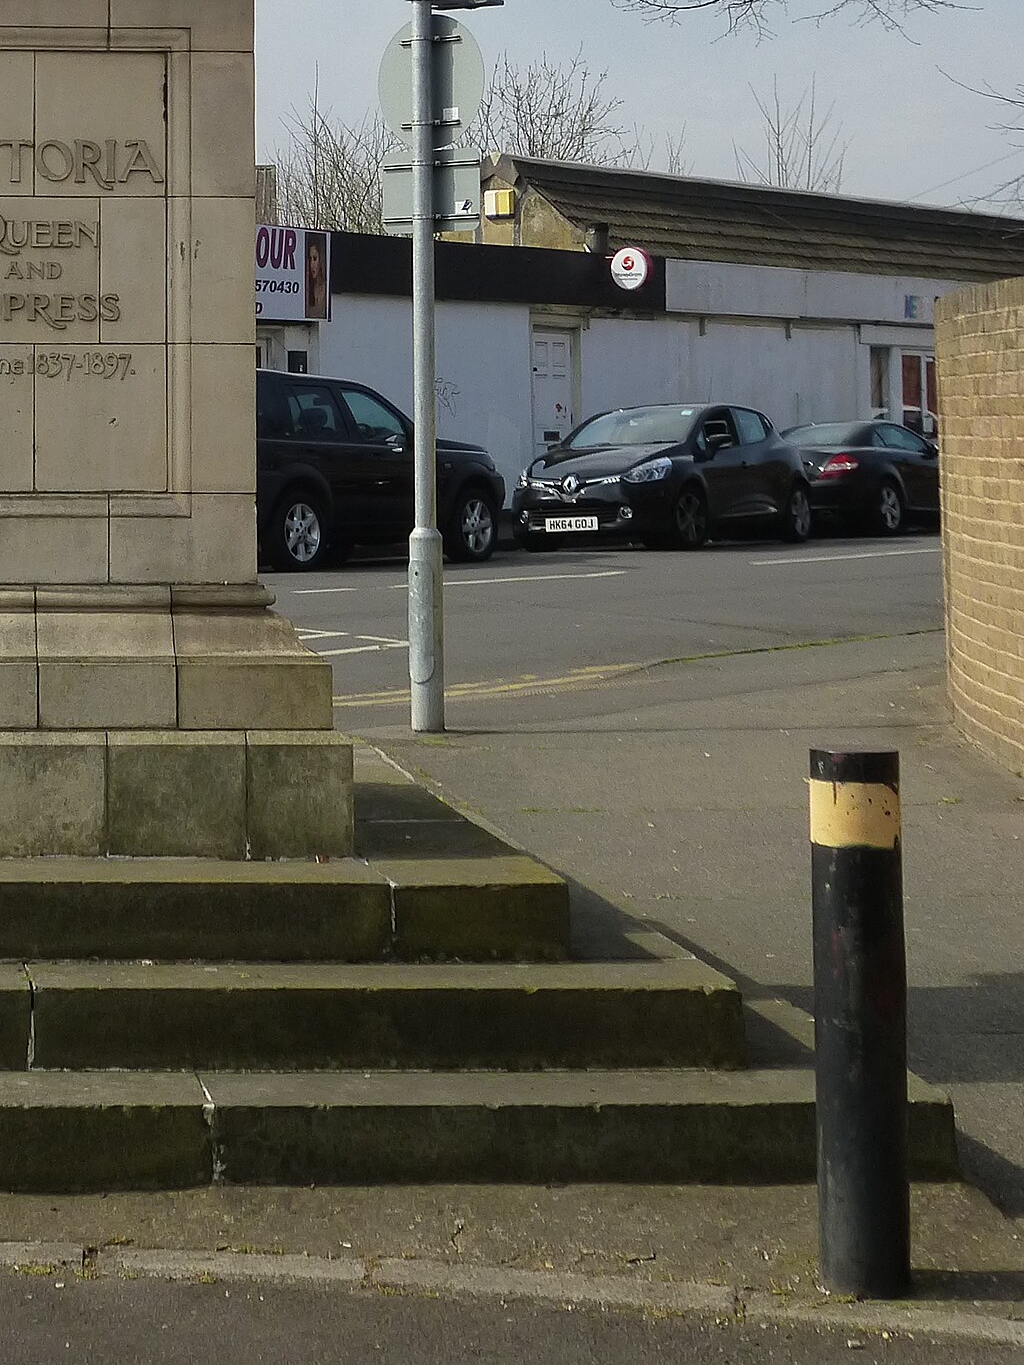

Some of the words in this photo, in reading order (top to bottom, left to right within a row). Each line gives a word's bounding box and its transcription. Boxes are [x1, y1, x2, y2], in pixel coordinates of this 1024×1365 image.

[4, 261, 62, 280] AND
[549, 520, 573, 530] HK64
[575, 519, 594, 529] GOJ
